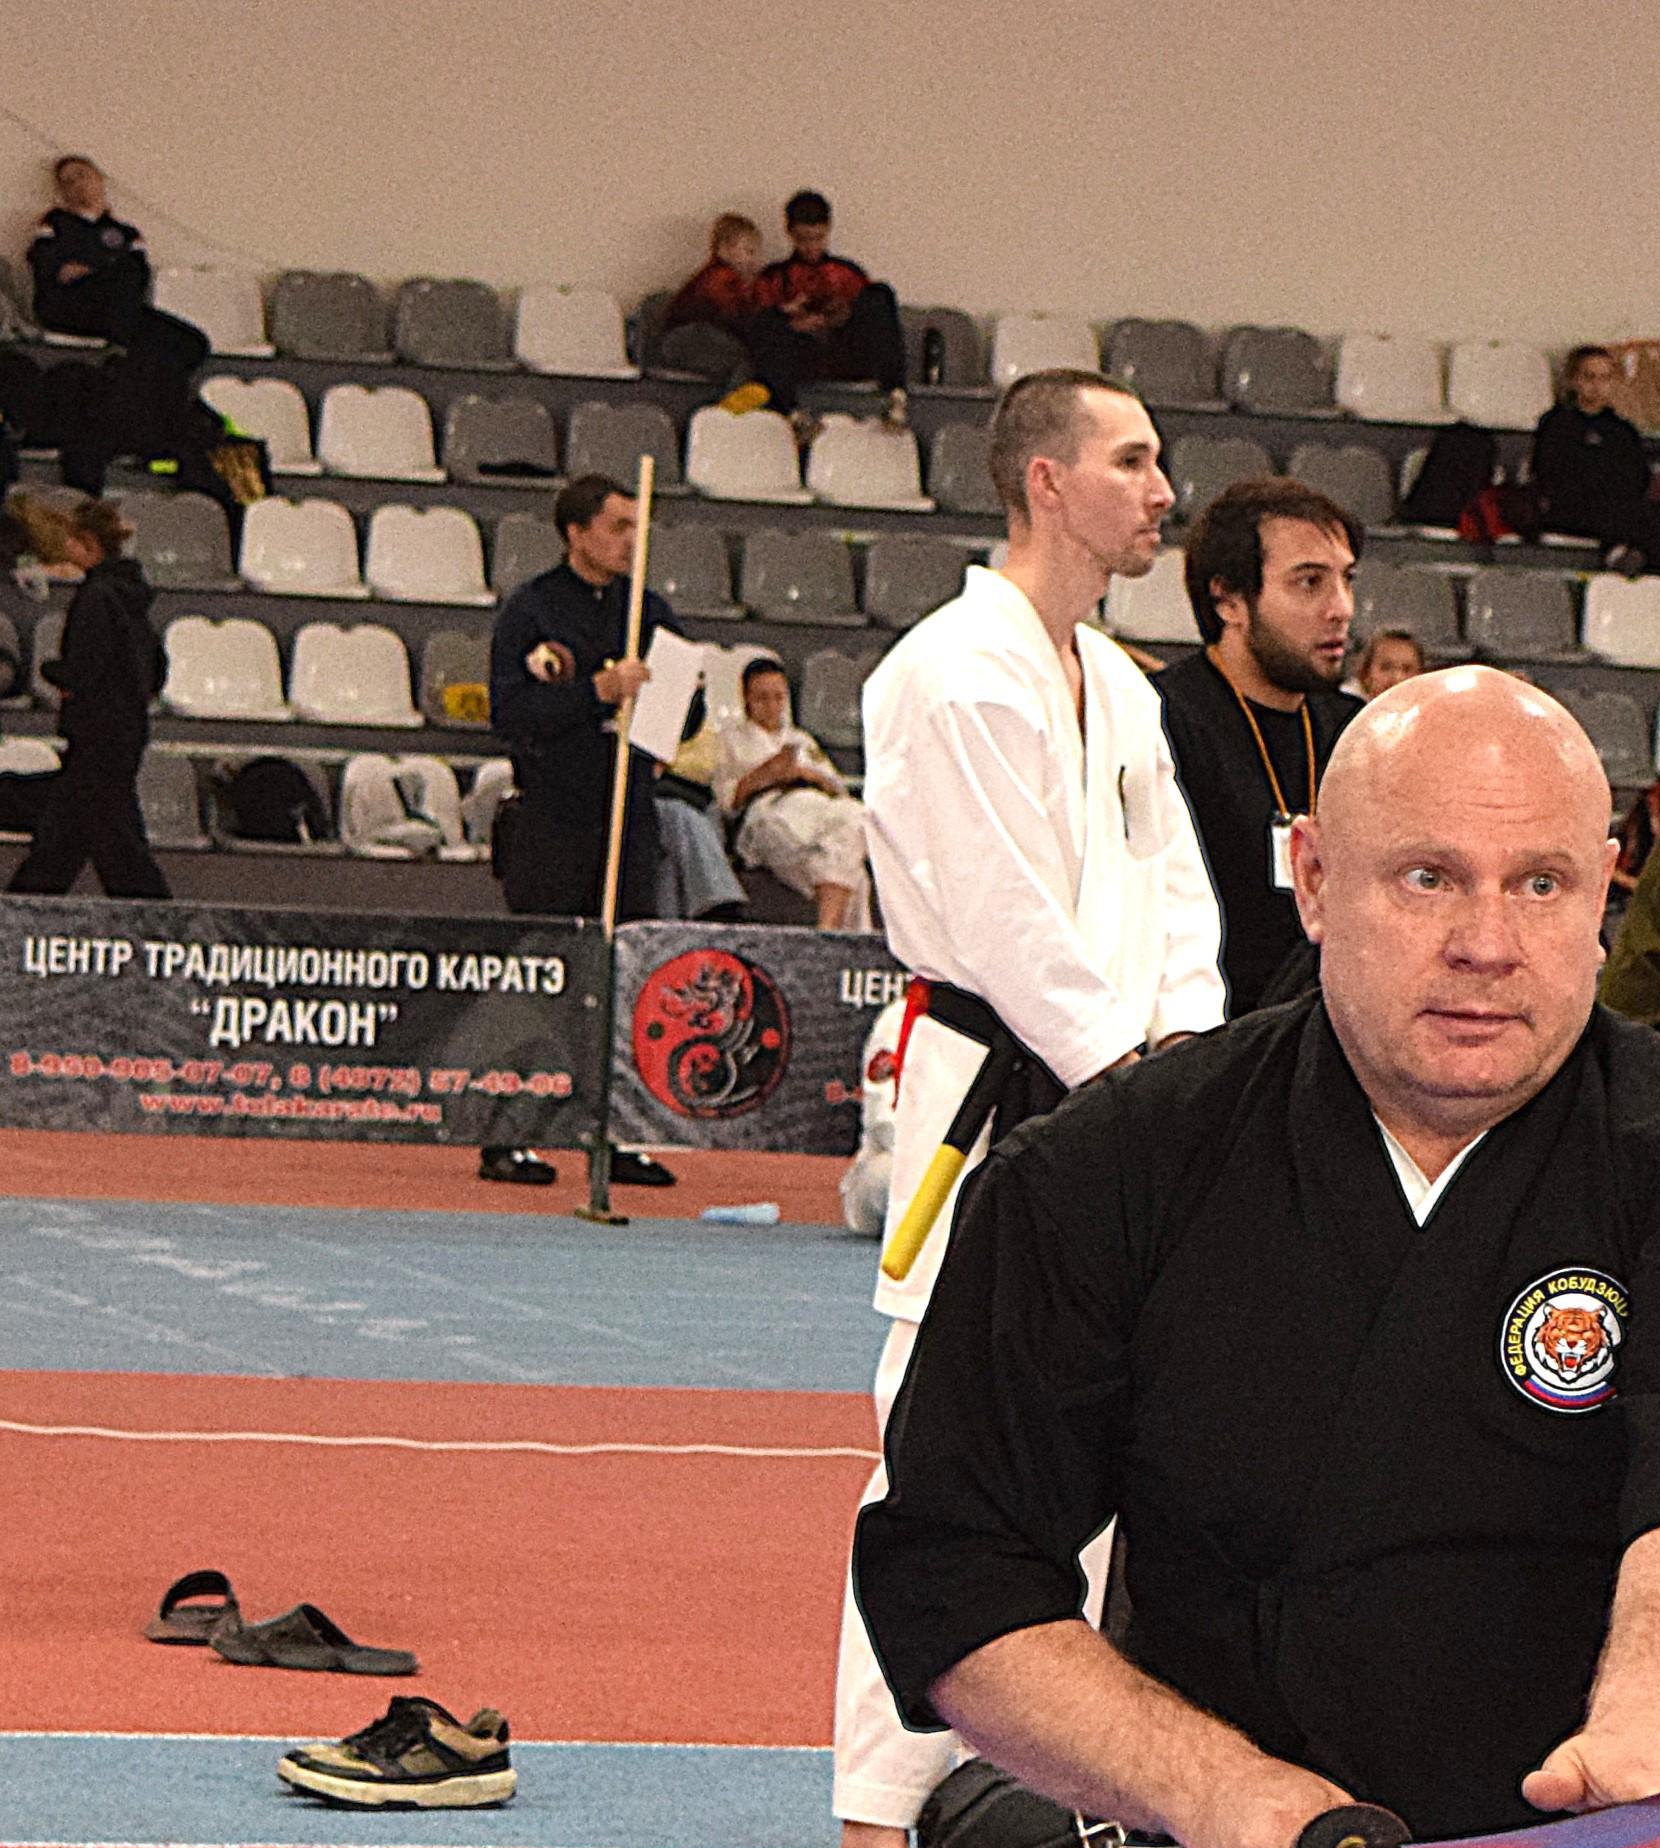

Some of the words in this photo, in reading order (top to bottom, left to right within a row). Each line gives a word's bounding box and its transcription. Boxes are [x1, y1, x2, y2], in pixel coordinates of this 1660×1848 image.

[24, 936, 133, 978] ЦЕНТР
[144, 941, 429, 989] ТРАДИЦИОННОГО
[436, 953, 566, 994] КАРАТЭ
[841, 969, 912, 1009] ЦЕН
[1508, 1289, 1545, 1376] ФЕДЕРАЦИЯ
[1548, 1276, 1629, 1317] КОБУДЗЮЦ
